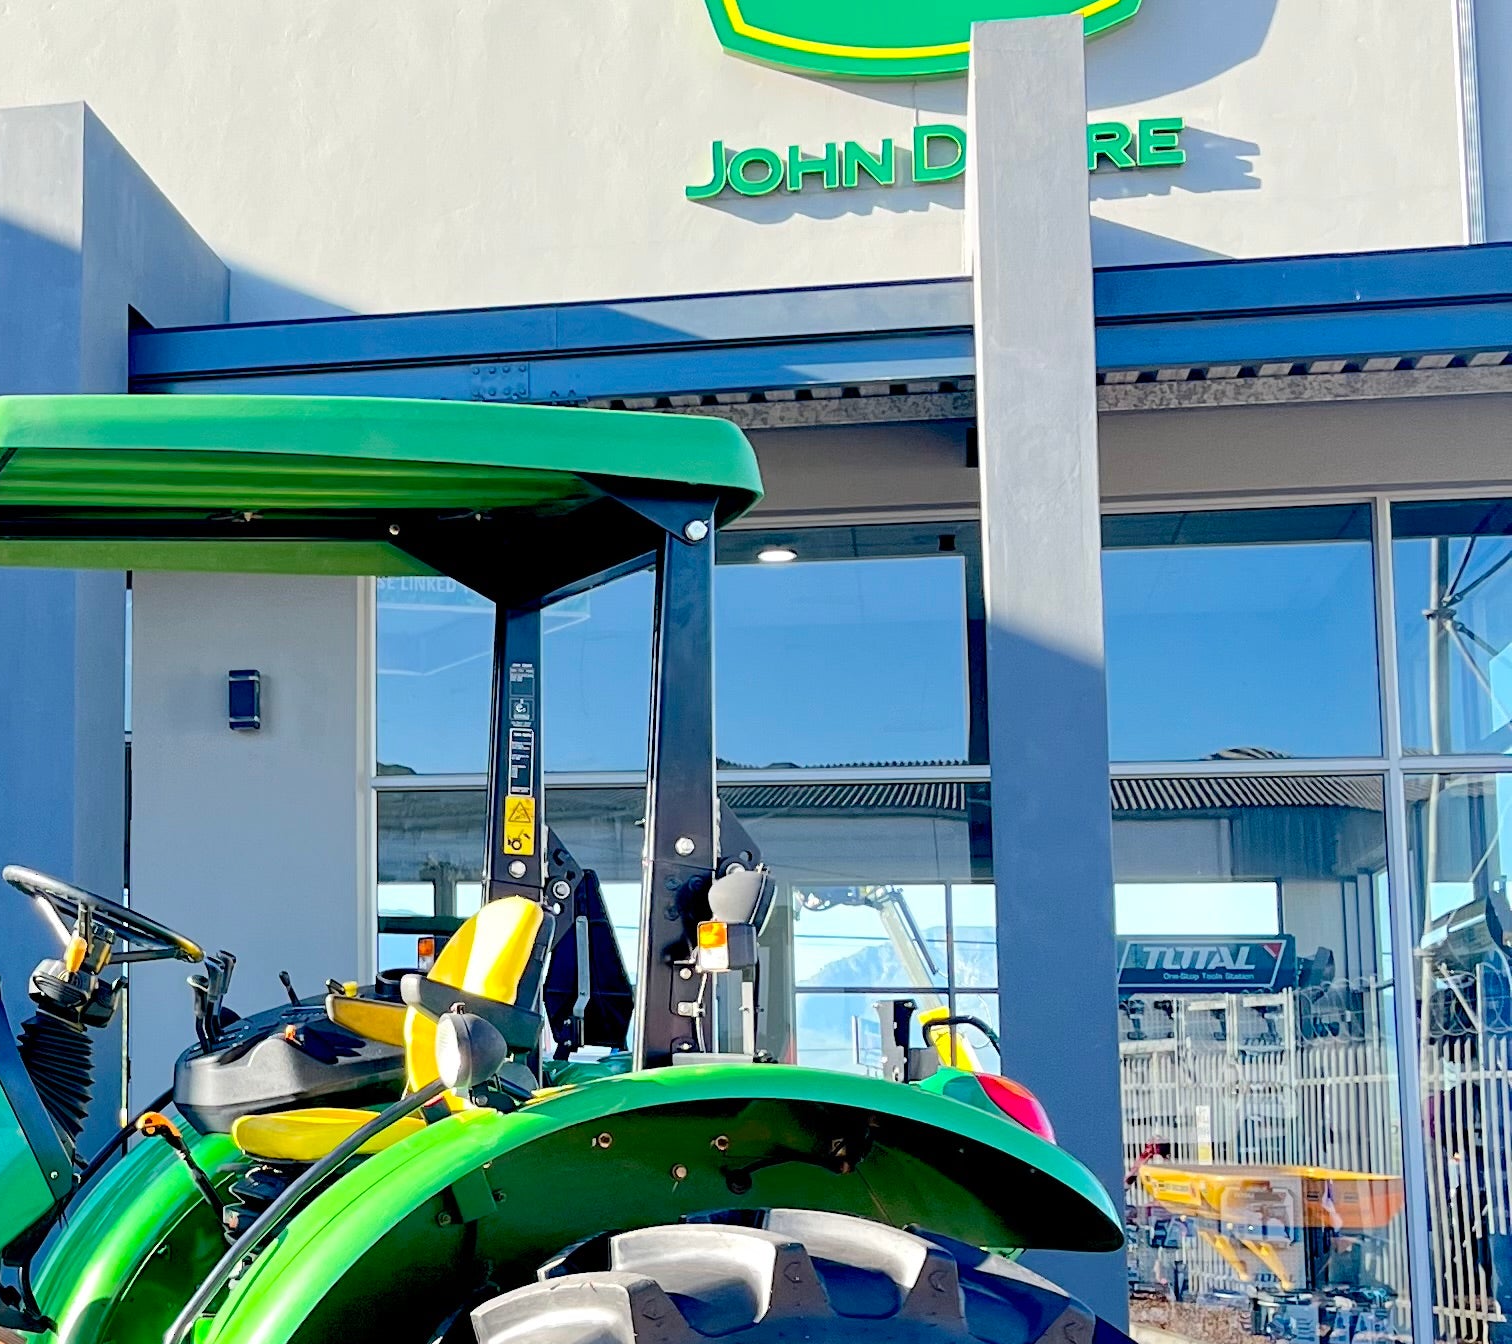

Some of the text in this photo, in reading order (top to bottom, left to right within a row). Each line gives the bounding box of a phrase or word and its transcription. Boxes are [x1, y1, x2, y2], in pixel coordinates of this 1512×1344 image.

[686, 117, 1187, 199] JOHN DRE
[1143, 946, 1256, 970] TOTAL
